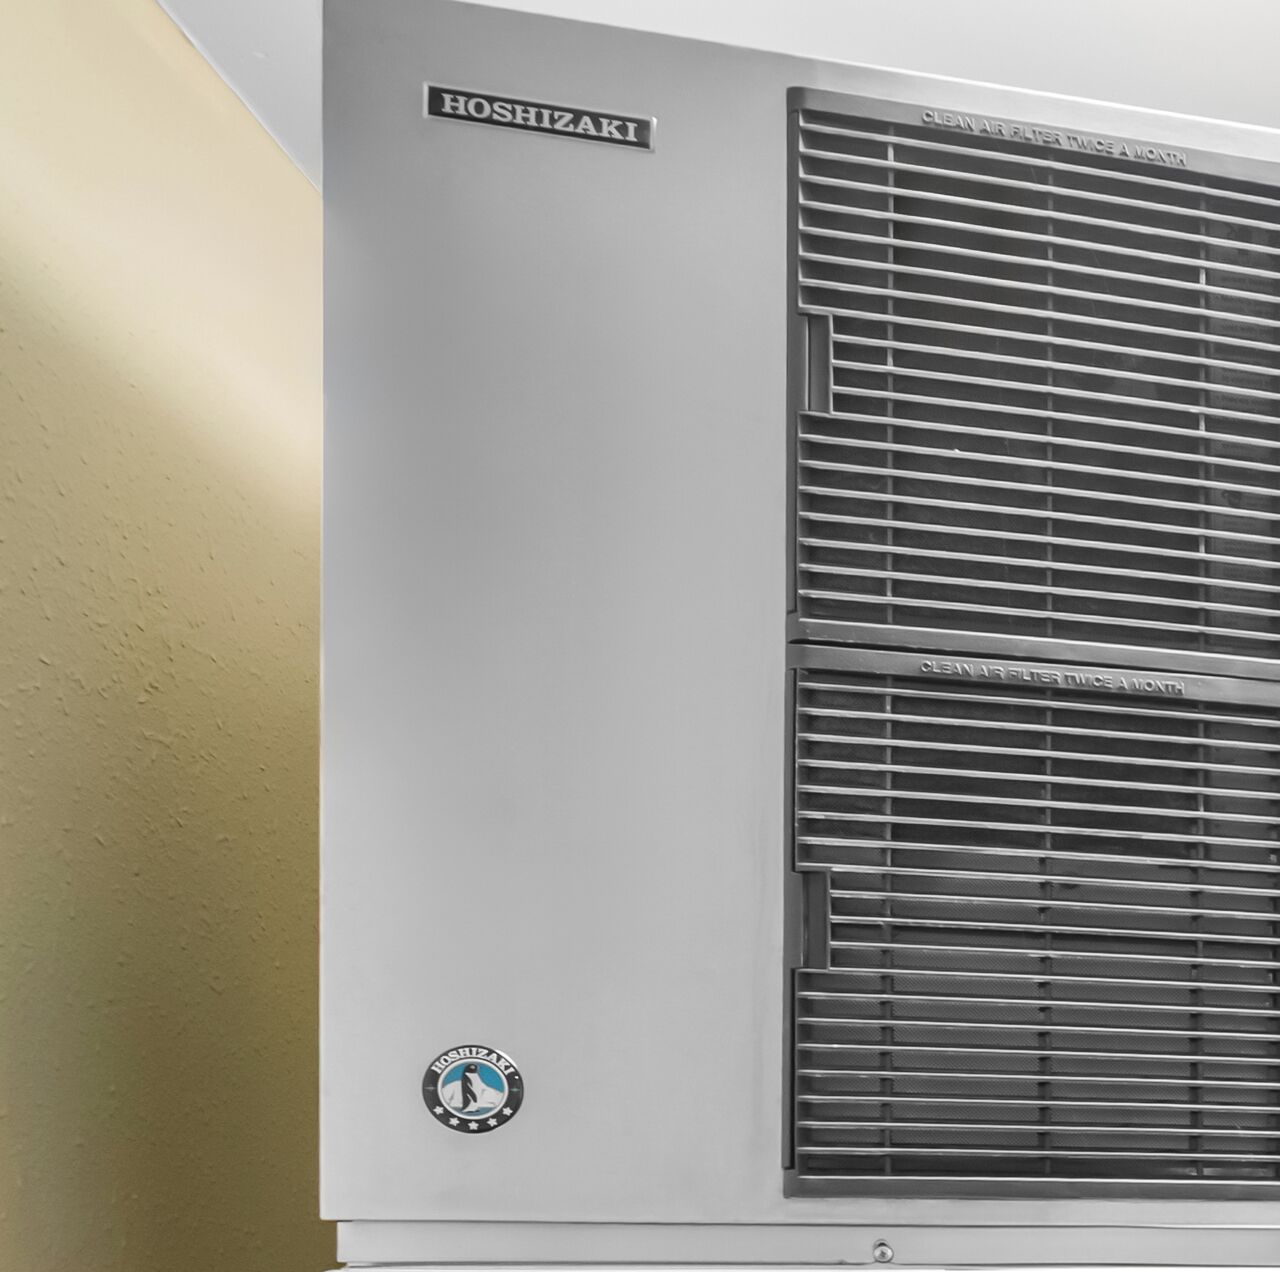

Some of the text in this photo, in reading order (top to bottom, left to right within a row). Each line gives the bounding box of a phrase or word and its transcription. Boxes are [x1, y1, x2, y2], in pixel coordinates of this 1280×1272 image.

[441, 93, 638, 142] HOSHIZAKI
[921, 110, 1187, 168] CLEAN AIR FILTER TWICE A MONTH
[921, 660, 1185, 696] CLEAN AIR FILTER TWICE A MONTH
[430, 1047, 516, 1075] HOSHIZAKI
